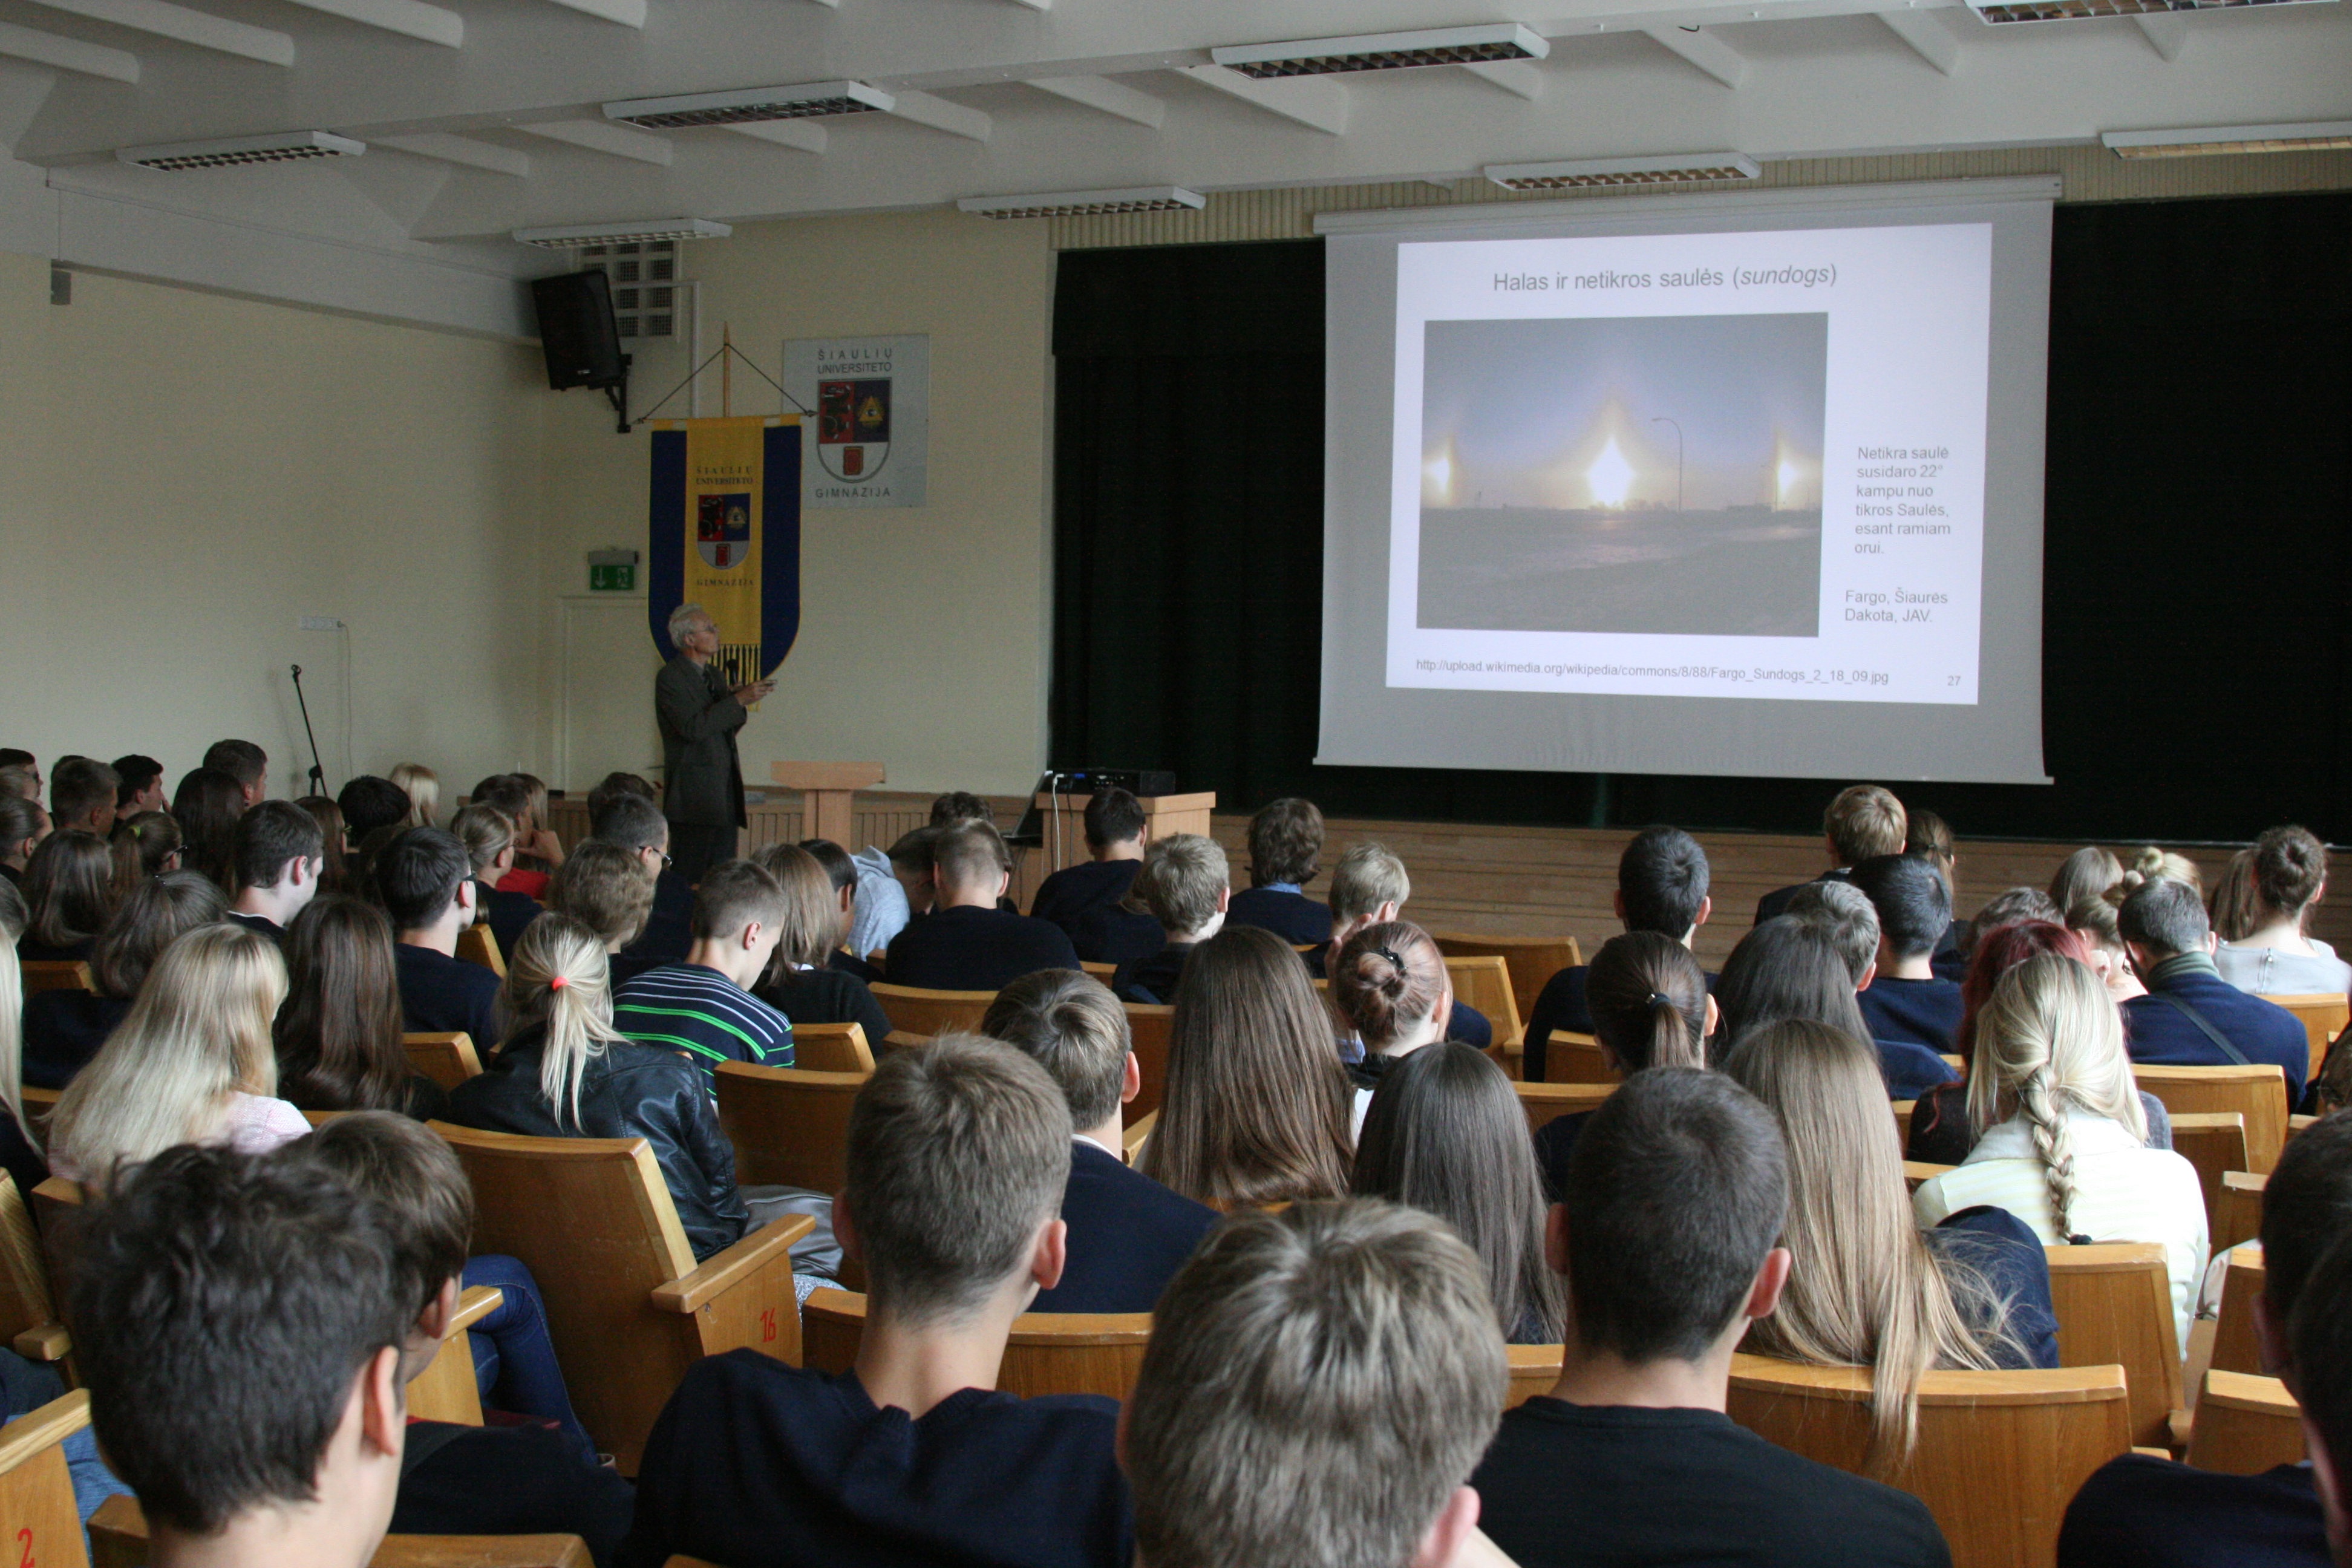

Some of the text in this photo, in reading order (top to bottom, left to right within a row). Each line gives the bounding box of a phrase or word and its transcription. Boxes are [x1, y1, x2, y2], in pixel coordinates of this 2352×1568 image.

[1494, 264, 1837, 291] Halas ir netikros saulės (sundogs)
[817, 362, 892, 374] UNIVERSITETO
[1858, 446, 1949, 460] Netikra saulė
[1857, 464, 1944, 478] susidaro 22°
[815, 488, 891, 498] GIMNAZIJA
[1857, 485, 1933, 500] kampu nuo
[1856, 503, 1949, 518] tikros Saulės,
[1855, 522, 1951, 535] esant ramiam
[1855, 541, 1884, 554] orui.
[696, 578, 754, 587] GIMNAZIJA
[1846, 587, 1949, 606] Fargo, Šiaurės
[1845, 608, 1933, 624] Dakota, JAV.
[1416, 659, 1889, 685] http://upload.wikimedia.org/wikipedia/commons/8/88/Fargo_Sundogs_2_18_09.jpg
[1947, 675, 1961, 686] 27
[759, 1307, 777, 1343] 16
[18, 1528, 36, 1568] 2
